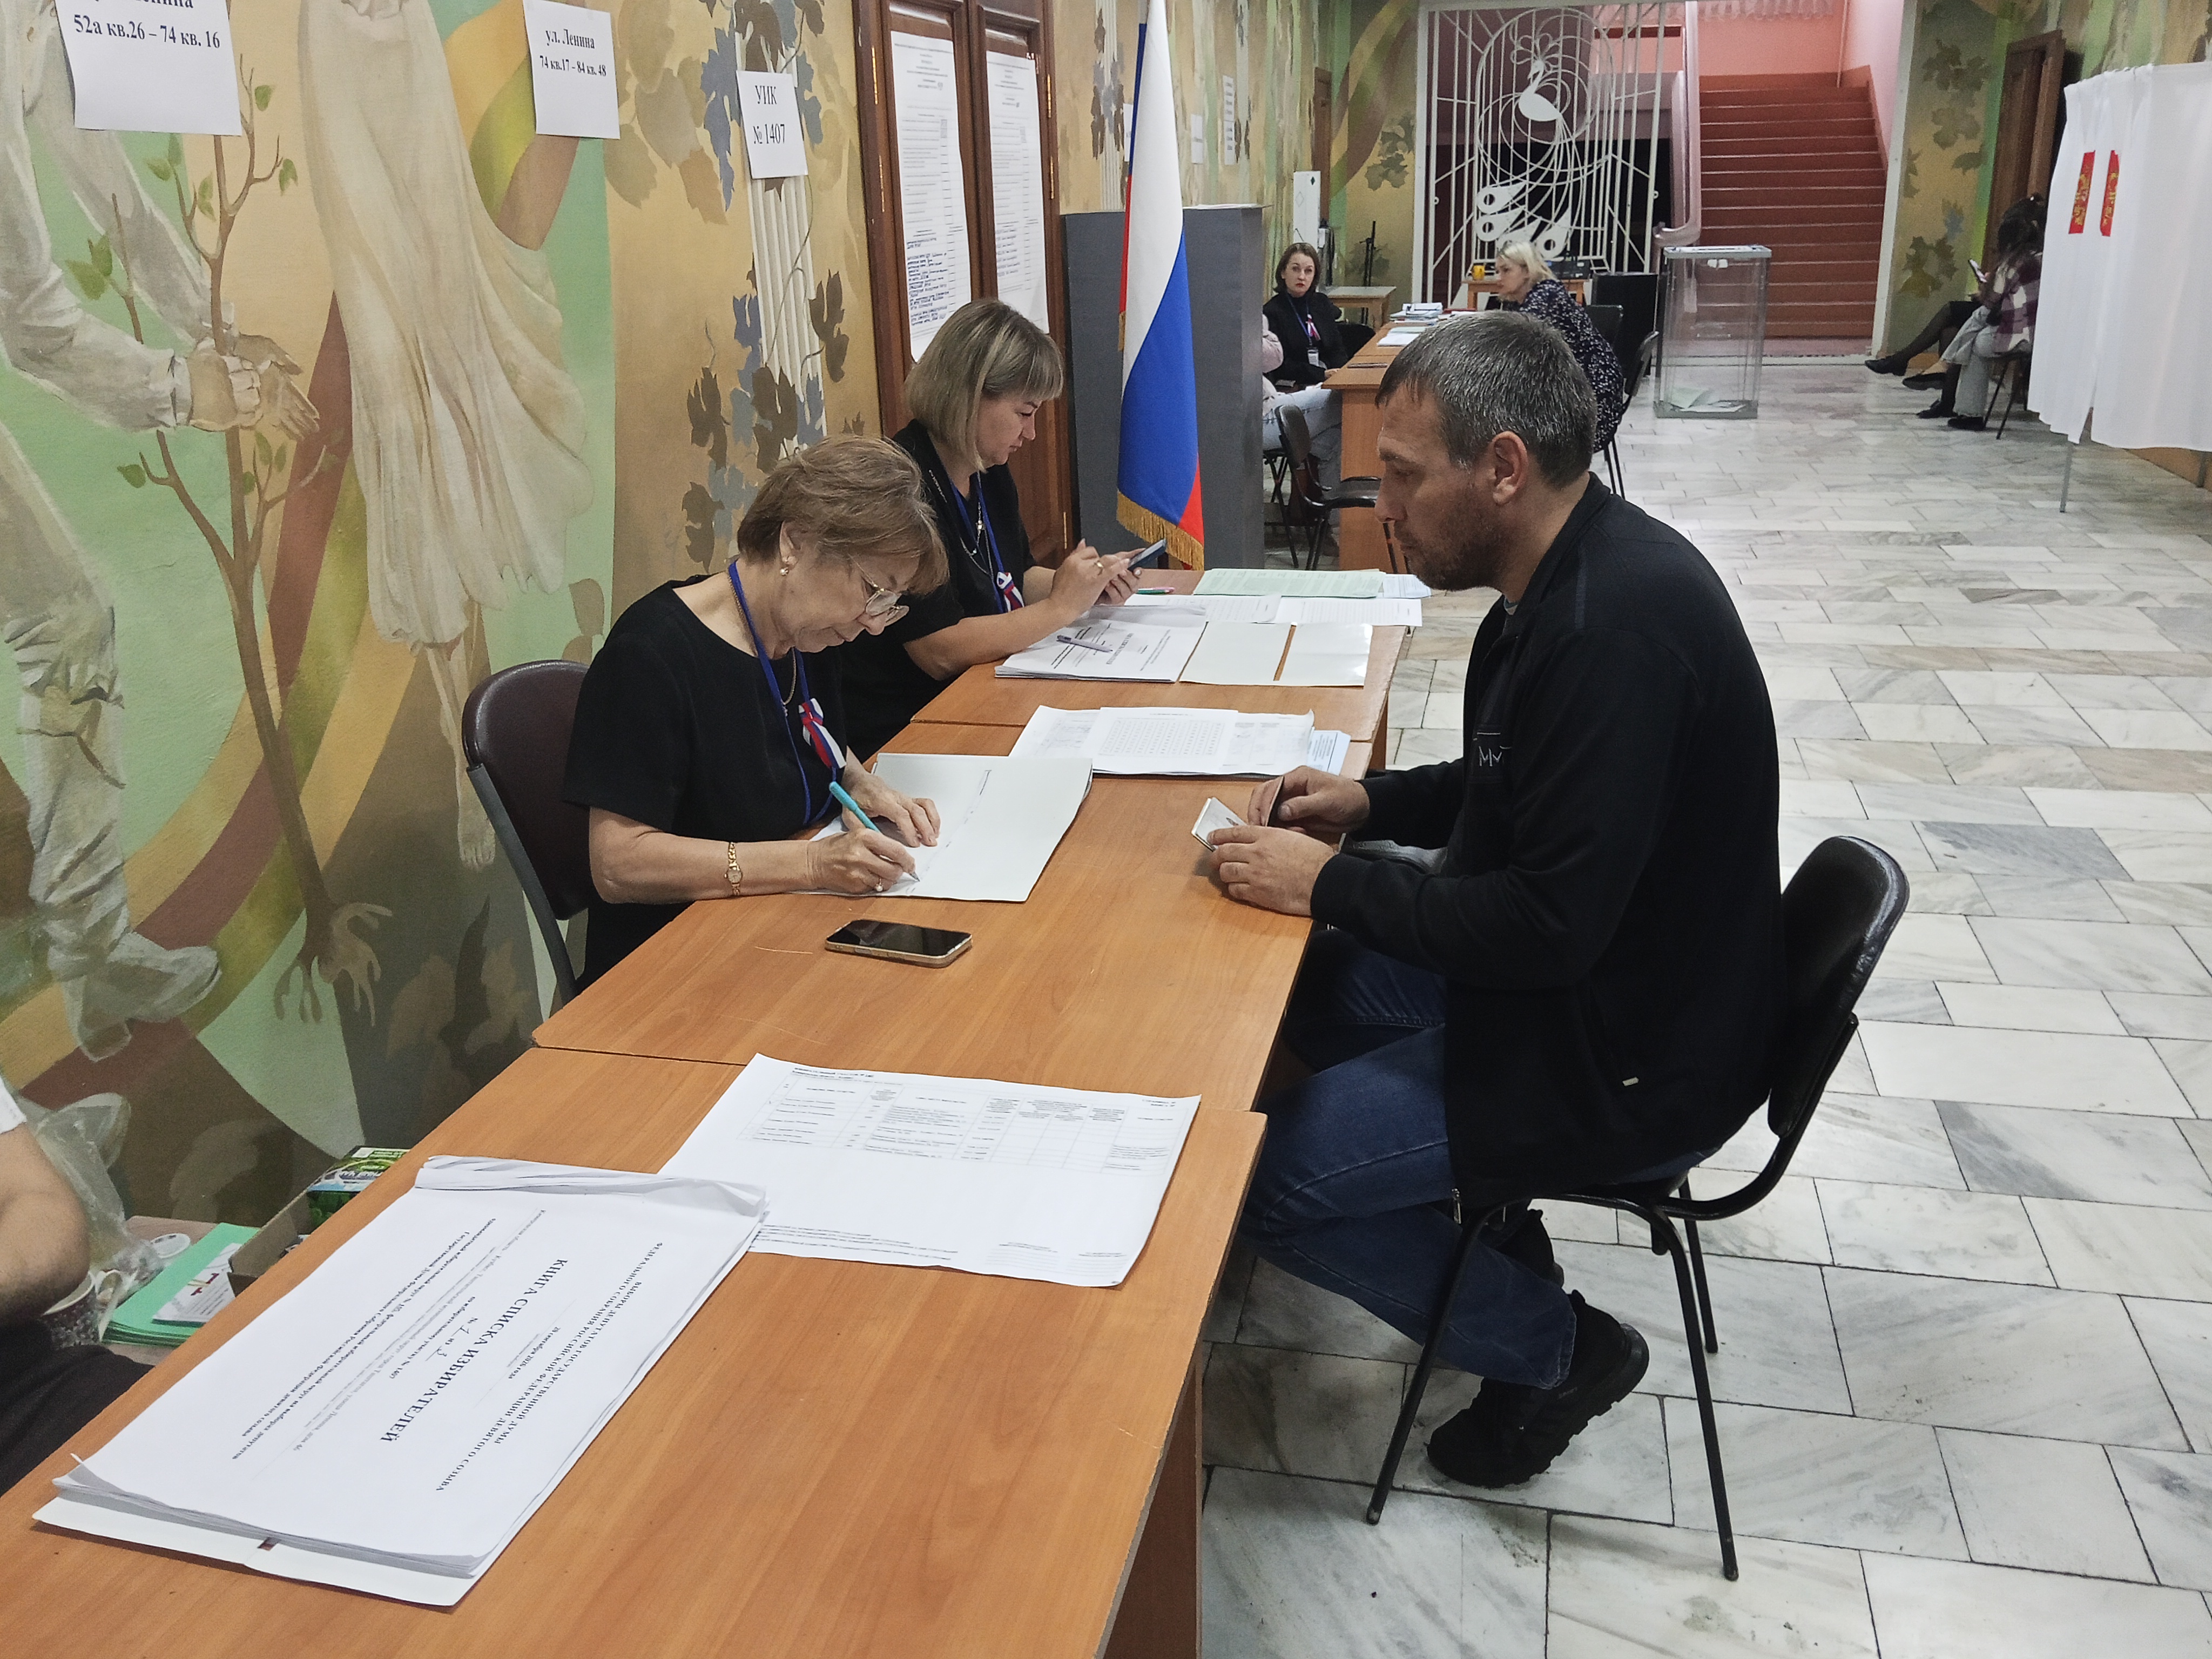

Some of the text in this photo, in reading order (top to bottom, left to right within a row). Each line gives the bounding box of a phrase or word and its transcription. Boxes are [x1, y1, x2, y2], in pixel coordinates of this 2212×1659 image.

[74, 14, 103, 35] 52а
[106, 21, 145, 40] кв.26
[160, 25, 177, 44] 74
[180, 32, 201, 47] кв.
[206, 30, 220, 49] 16
[562, 28, 595, 49] Ленина
[539, 55, 549, 69] 74
[550, 58, 570, 72] кв.17
[576, 60, 585, 74] 84
[598, 64, 607, 77] 48
[754, 85, 778, 105] УИК
[752, 123, 785, 144] № 1407
[523, 1259, 569, 1295] КНИГА
[618, 1242, 663, 1290] ФЕДЕРАЛЬНОГО
[586, 1291, 621, 1325] СОБРАНИЯ
[614, 1282, 642, 1309] ВЫБОРЫ
[473, 1298, 528, 1345] СПИСКА
[579, 1310, 617, 1348] ДЕПУТАТОВ
[431, 1347, 448, 1357] 3
[544, 1326, 590, 1372] РОССИЙСКОЙ
[379, 1348, 480, 1442] ИЗБИРАТЕЛЕЙ
[504, 1373, 547, 1417] ФЕДЕРАЦИИ
[516, 1350, 582, 1420] ГОСУДАРСТВЕННОЙ
[468, 1417, 507, 1457] ДЕВЯТОГО
[494, 1420, 518, 1444] ДУМЫ
[435, 1459, 469, 1491] СОЗЫВА
